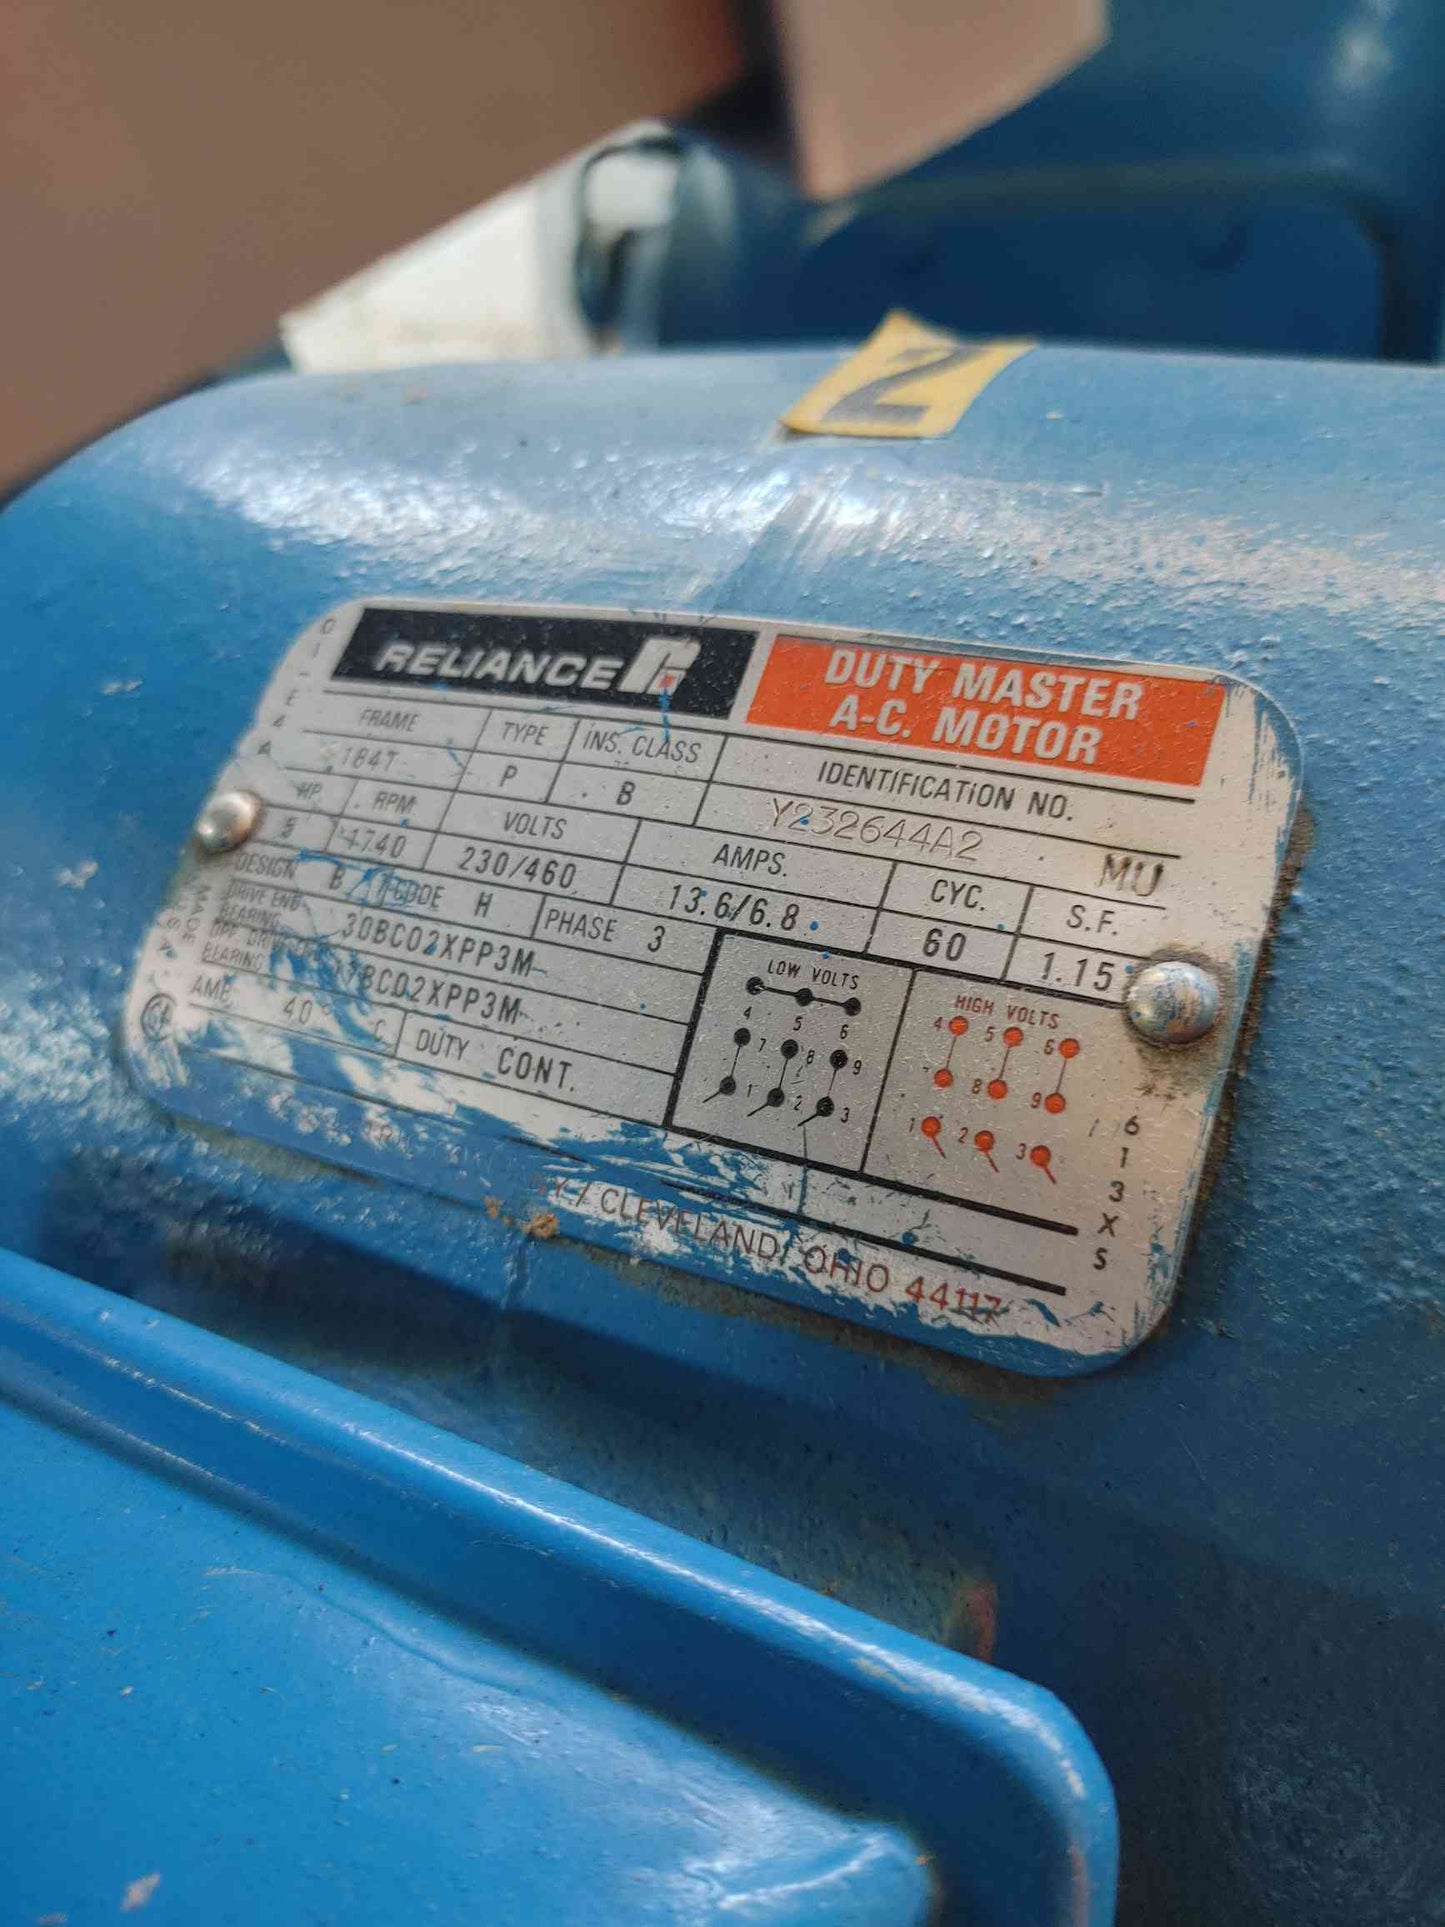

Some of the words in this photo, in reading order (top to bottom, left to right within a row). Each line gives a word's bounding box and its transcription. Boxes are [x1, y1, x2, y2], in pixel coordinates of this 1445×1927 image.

[375, 643, 624, 689] RELIANCE
[824, 649, 941, 694] DUTY
[952, 663, 1143, 721] MASTER
[359, 708, 420, 733] FRAME
[502, 721, 549, 746] TYPE
[829, 694, 912, 738] A-C.
[932, 707, 1103, 765] MOTOR
[342, 747, 400, 772] 184T
[582, 730, 622, 756] INS.
[632, 735, 702, 764] CLASS
[500, 765, 518, 787] P
[297, 780, 323, 801] HP
[372, 791, 417, 816] RPM
[616, 781, 636, 806] B
[817, 761, 1015, 811] IDENTIFICATION
[1027, 791, 1073, 821] NO.
[504, 811, 568, 840] VOLTS
[772, 797, 984, 861] Y232644A2
[346, 828, 407, 859] 1740
[235, 852, 297, 880] DESIGN
[329, 867, 346, 890] B
[458, 846, 577, 889] 230/460
[713, 843, 788, 877] AMPS.
[1098, 853, 1164, 897] MU
[474, 892, 494, 918] H
[668, 884, 800, 931] 13.6/6.8
[930, 879, 984, 912] CYC.
[544, 909, 618, 943] PHASE
[648, 925, 666, 953] 3
[1066, 904, 1118, 936] S.F.
[342, 913, 536, 978] 30BC02XPP3M
[923, 928, 966, 962] 60
[768, 959, 800, 979] LOW
[812, 967, 860, 990] VOLTS
[1039, 952, 1116, 992] 1.15
[743, 1006, 753, 1020] 4
[793, 1016, 803, 1031] 5
[933, 1016, 943, 1032] 4
[955, 994, 994, 1017] HIGH
[1007, 1005, 1060, 1030] VOLTS
[758, 1038, 767, 1052] 7
[839, 1024, 849, 1040] 6
[985, 1026, 995, 1043] 5
[416, 1028, 470, 1062] DUTY
[497, 1046, 576, 1093] CONT.
[806, 1050, 816, 1065] 8
[1044, 1039, 1054, 1055] 6
[852, 1060, 863, 1076] 9
[971, 1079, 982, 1095] 8
[1031, 1092, 1042, 1109] 9
[793, 1095, 803, 1111] 2
[840, 1107, 850, 1124] 3
[958, 1127, 968, 1144] 2
[1016, 1143, 1026, 1160] 3
[803, 1245, 890, 1293] OHIO
[905, 1276, 1003, 1324] 44117
